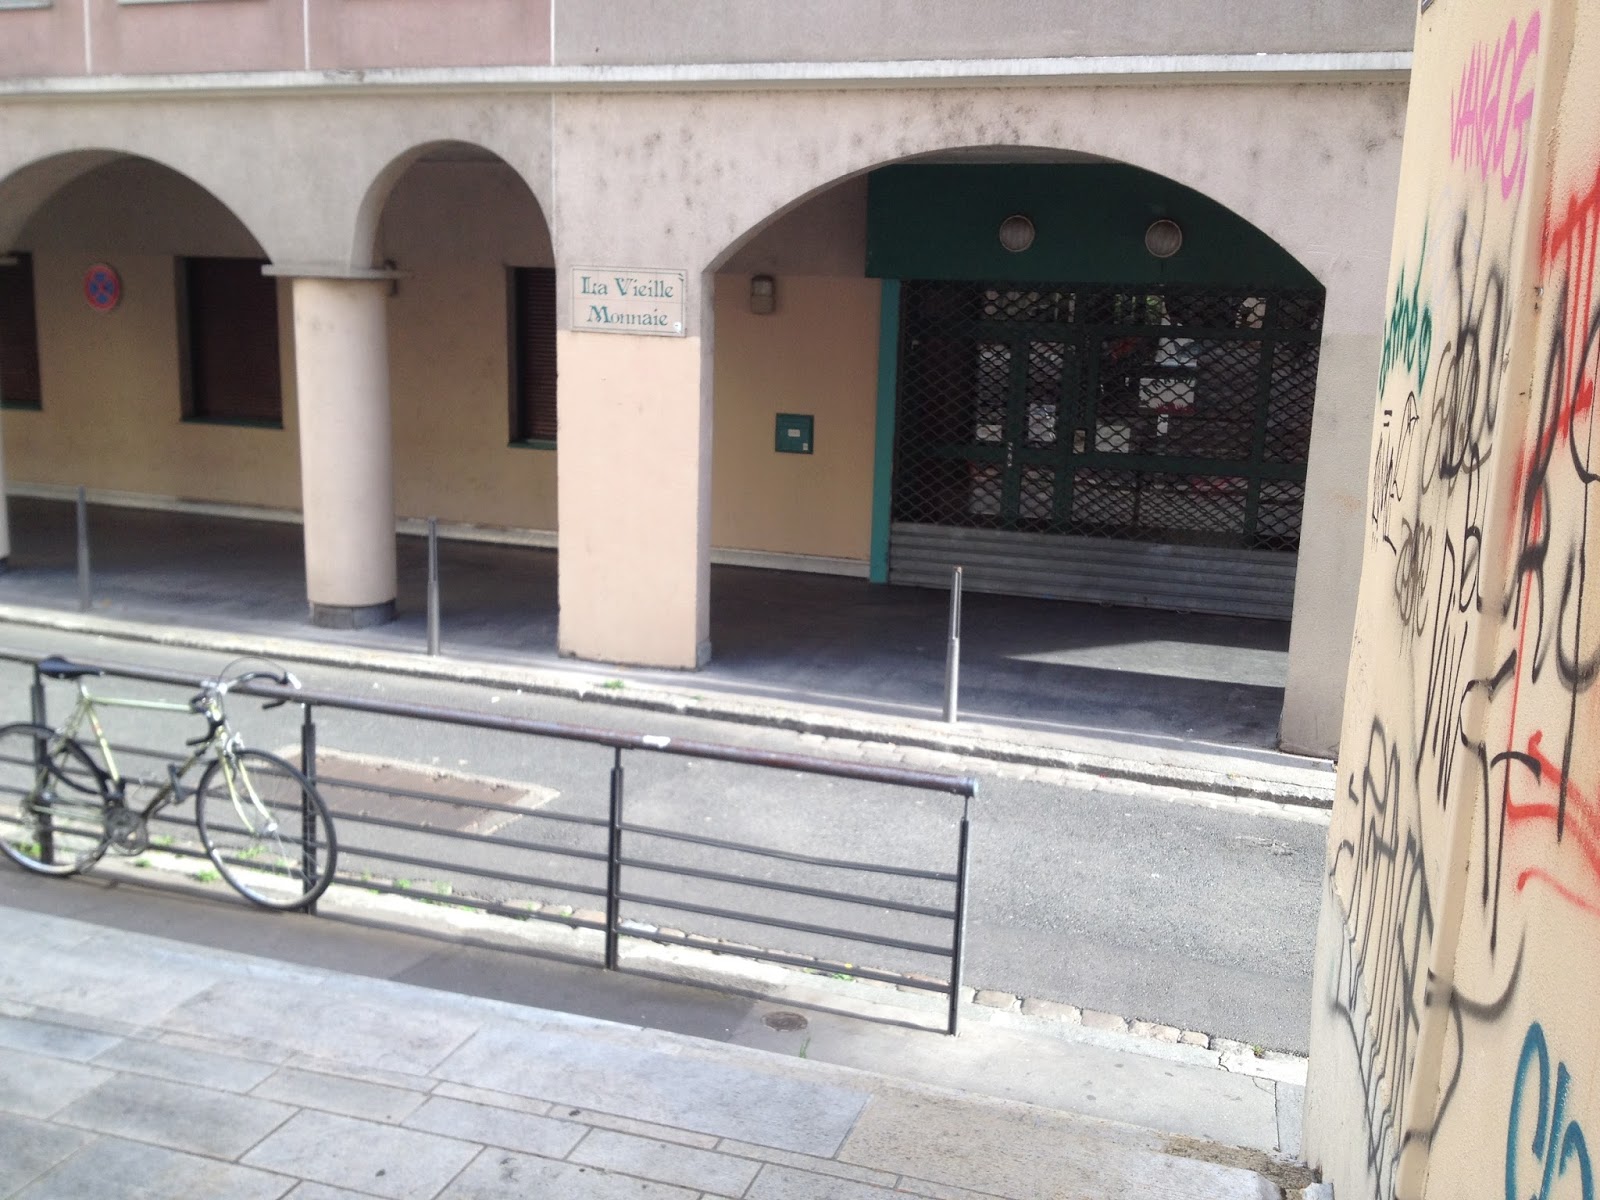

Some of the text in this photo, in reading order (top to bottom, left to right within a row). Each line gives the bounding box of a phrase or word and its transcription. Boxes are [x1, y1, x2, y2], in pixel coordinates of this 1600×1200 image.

[580, 276, 674, 298] La Vieille
[586, 305, 668, 326] Monnaie
